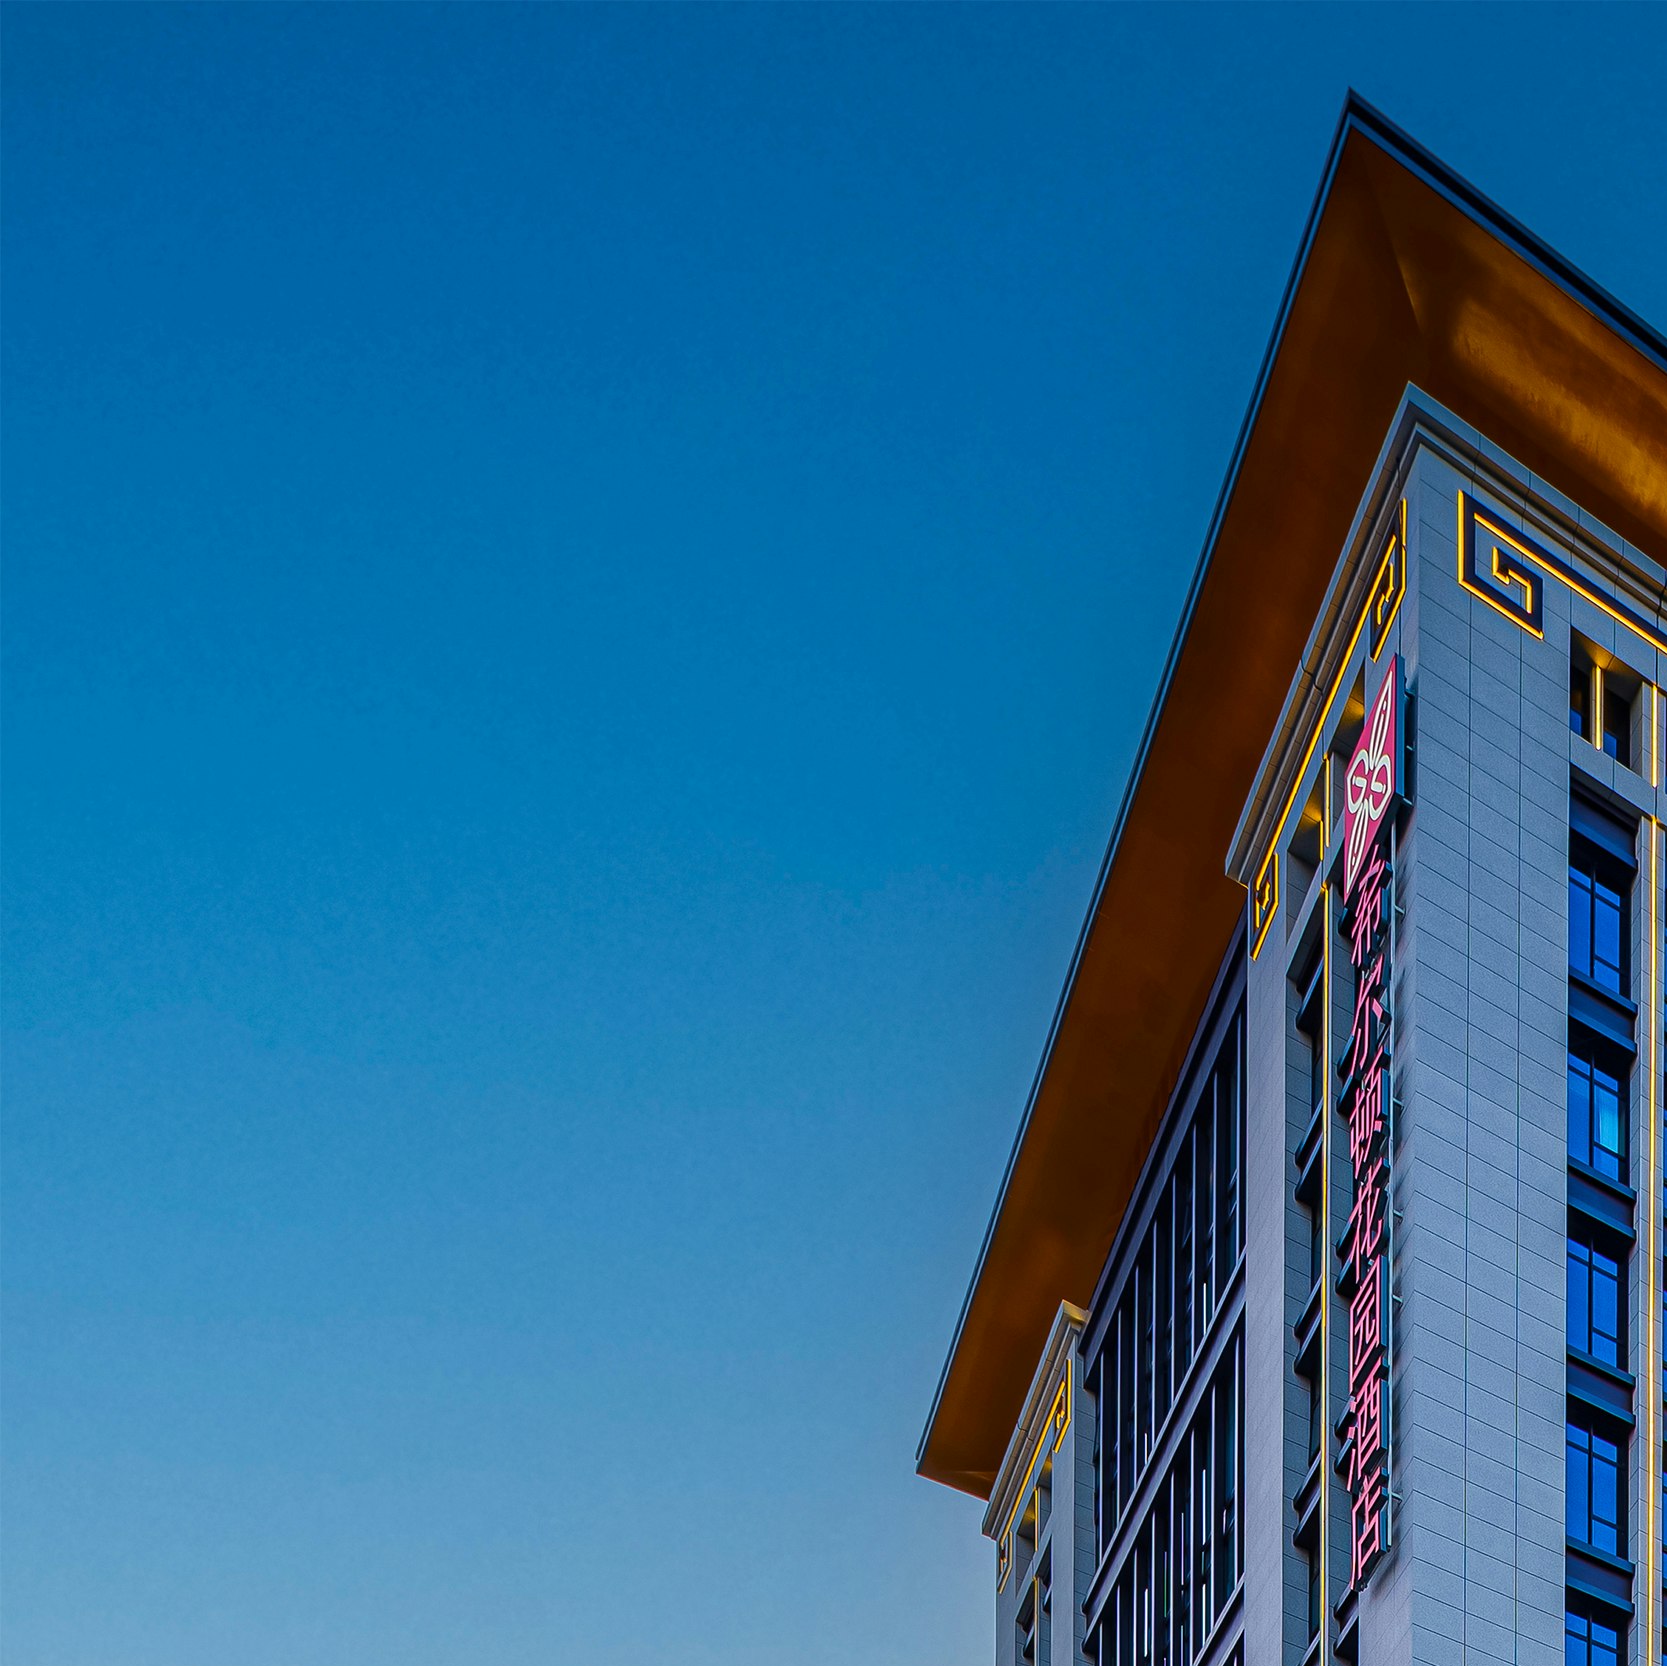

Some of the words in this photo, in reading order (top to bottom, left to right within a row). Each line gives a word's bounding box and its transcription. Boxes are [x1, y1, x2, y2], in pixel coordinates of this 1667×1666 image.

[1349, 842, 1390, 1591] 希尔顿花园酒店
